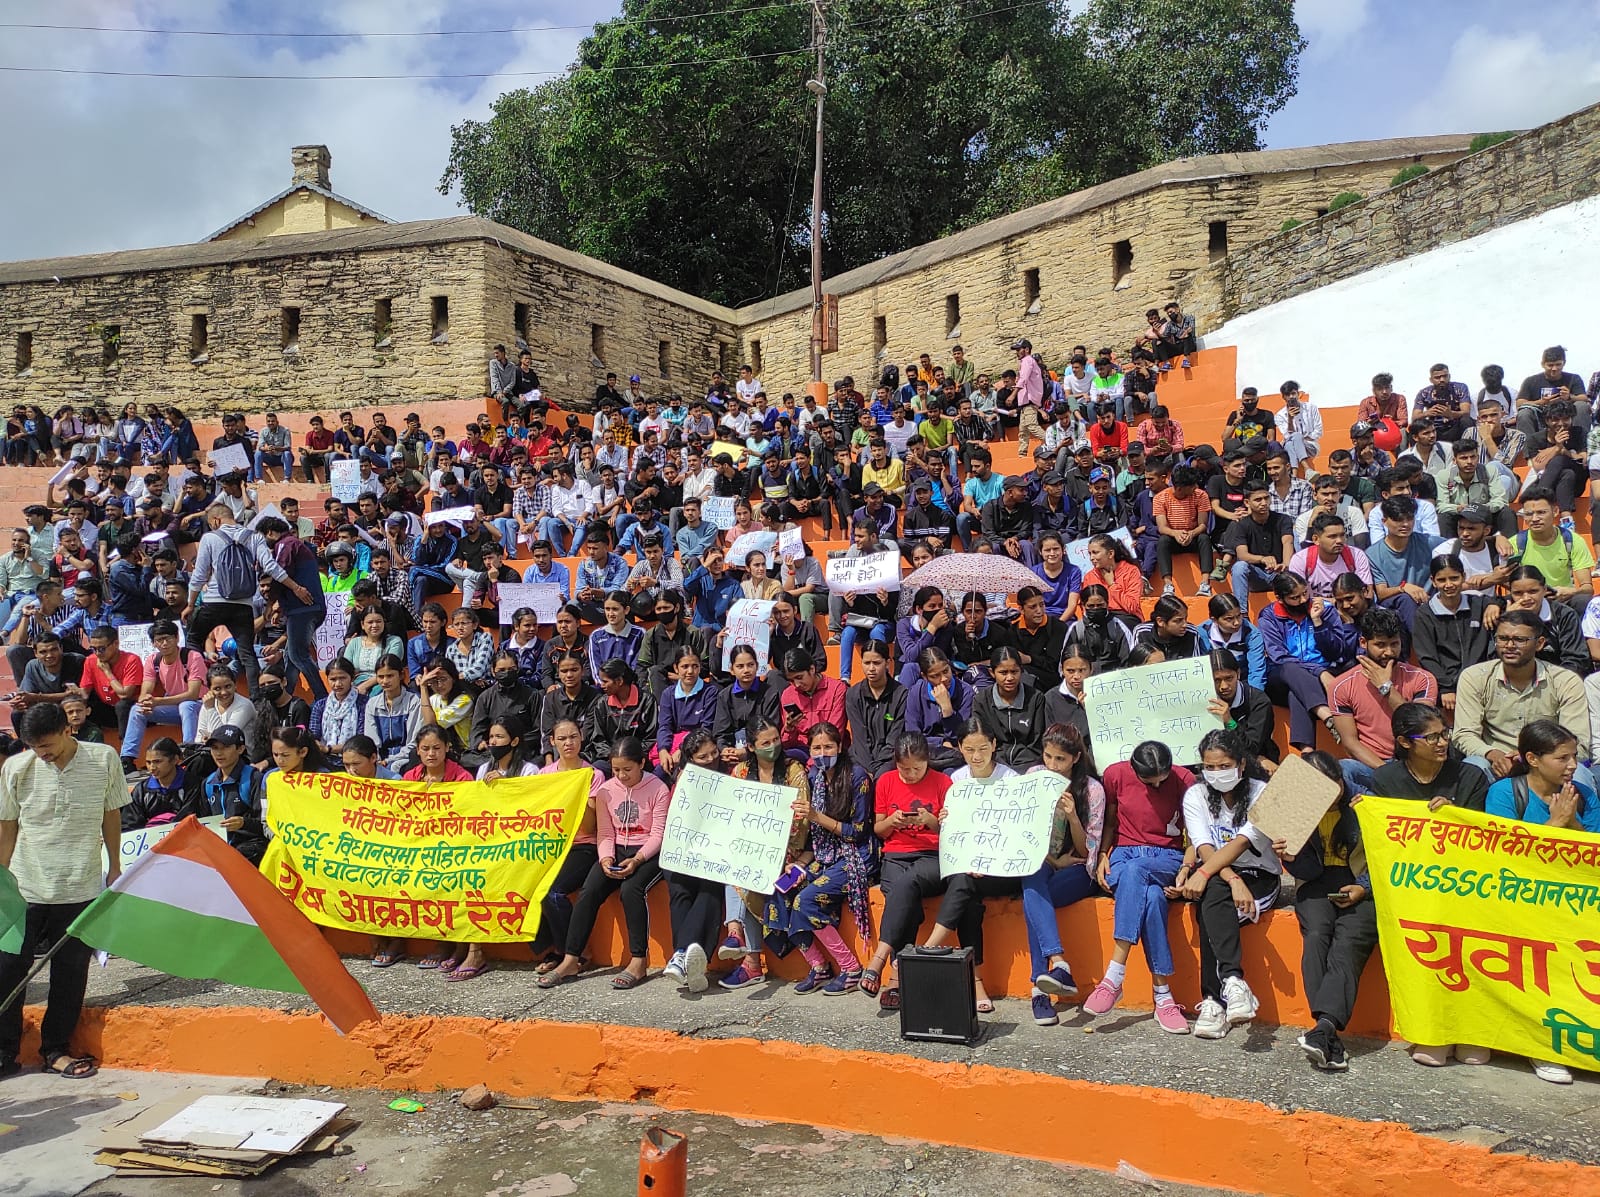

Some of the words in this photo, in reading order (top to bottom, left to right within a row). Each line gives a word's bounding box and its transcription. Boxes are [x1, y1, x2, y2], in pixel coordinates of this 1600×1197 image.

[317, 645, 336, 662] CBI
[1090, 671, 1139, 699] किसके
[1146, 667, 1189, 690] शासन
[1095, 722, 1124, 744] कौन
[1159, 715, 1202, 734] इसका
[319, 773, 376, 800] युवाओं
[376, 783, 398, 807] की
[677, 788, 692, 811] के
[686, 770, 725, 795] भर्ती
[732, 784, 783, 808] दलाली
[1011, 778, 1039, 798] नाम
[1042, 776, 1066, 792] पर
[342, 807, 400, 836] भर्तियों
[398, 811, 419, 837] में
[466, 810, 500, 841] नहीं
[499, 808, 566, 839] स्वीकार
[970, 797, 1041, 825] लीपापोती
[668, 816, 711, 848] वितरक
[728, 837, 767, 861] हाकम
[948, 829, 971, 848] बंद
[1429, 820, 1507, 855] युवाओं
[1501, 825, 1539, 858] की
[302, 851, 320, 876] में
[391, 864, 411, 888] के
[414, 866, 487, 892] खिलाफ
[420, 841, 472, 871] सहित
[470, 840, 518, 865] तमाम
[969, 851, 997, 873] बंद
[333, 890, 460, 937] आक्रोश
[466, 889, 529, 936] रैली
[1399, 918, 1559, 997] युवा
